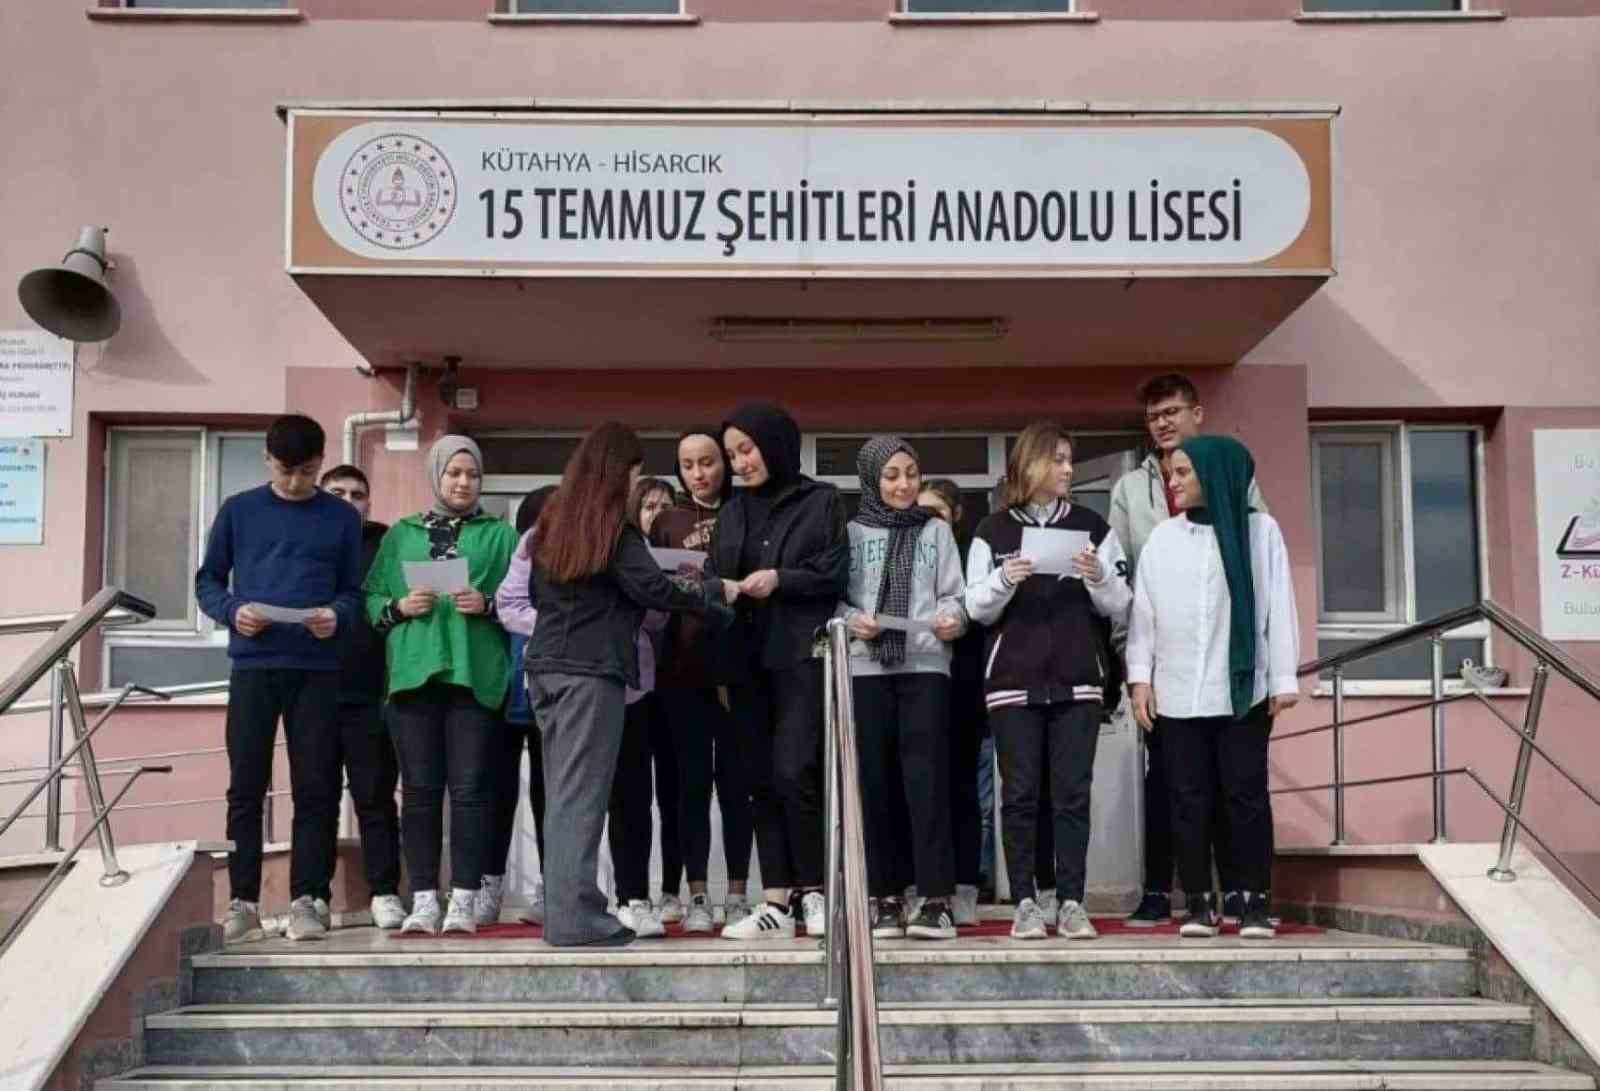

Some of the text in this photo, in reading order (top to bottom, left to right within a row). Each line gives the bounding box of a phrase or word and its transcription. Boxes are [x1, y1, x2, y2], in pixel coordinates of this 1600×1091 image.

[481, 147, 592, 173] KÜTAHYA
[613, 149, 723, 174] HİSARCIK
[478, 188, 524, 240] 15
[533, 187, 706, 242] TEMMUZ
[716, 178, 916, 257] ŞEHİTLERİ
[928, 190, 1114, 243] ANADOLU
[1128, 178, 1242, 243] LİSESİ
